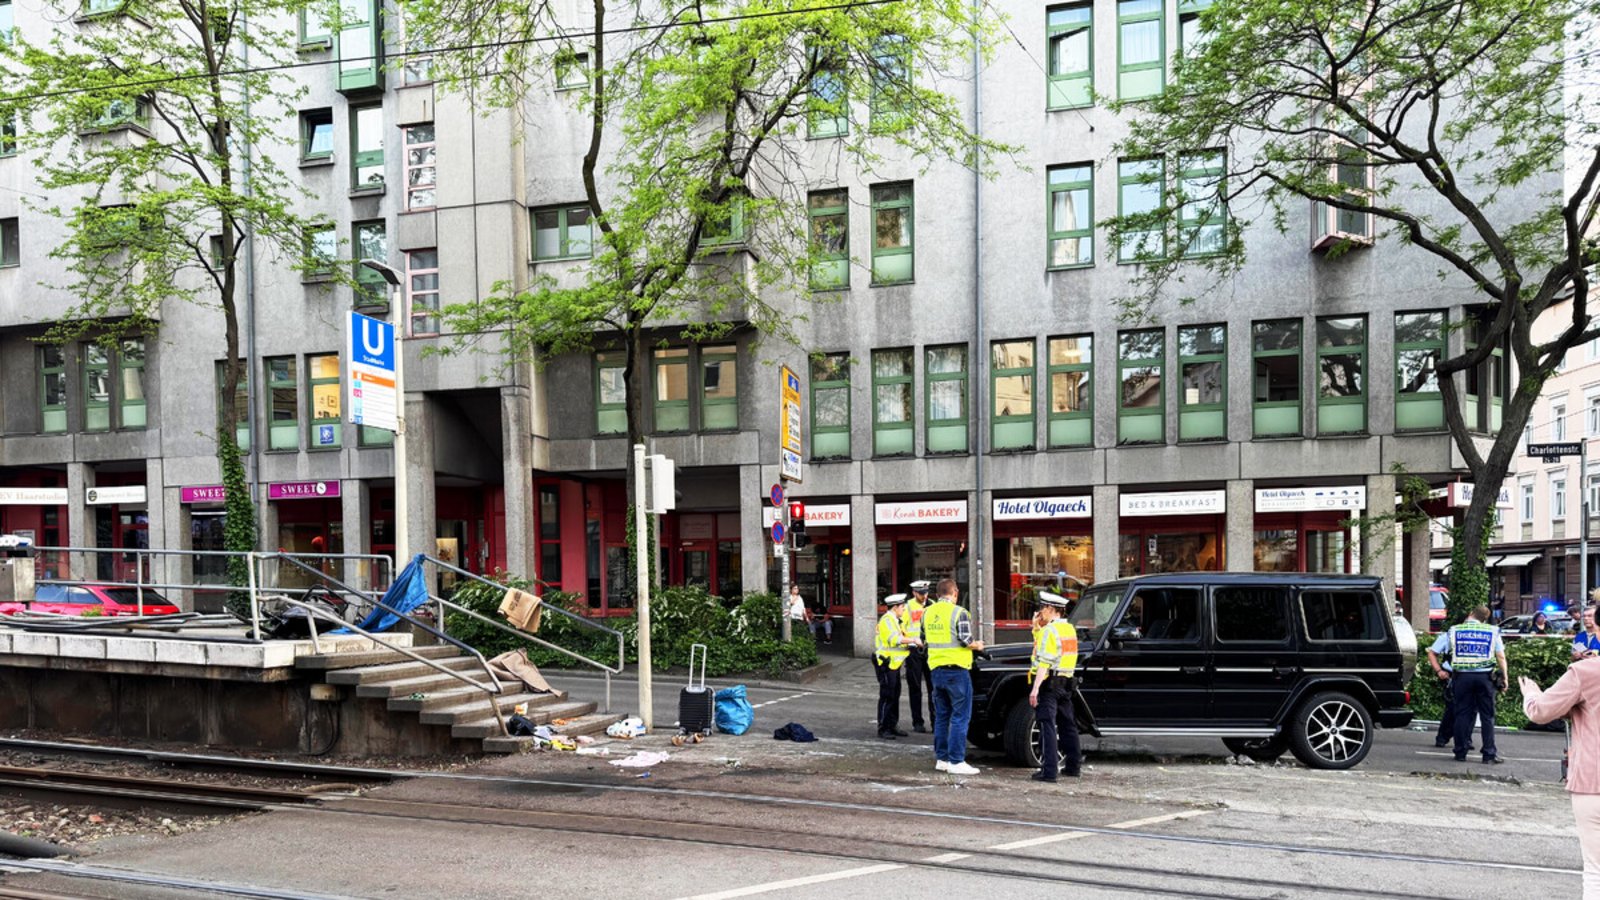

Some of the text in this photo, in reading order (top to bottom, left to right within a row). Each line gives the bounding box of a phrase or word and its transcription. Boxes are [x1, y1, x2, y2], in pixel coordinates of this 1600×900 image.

[362, 318, 384, 356] U
[998, 499, 1087, 516] Hotel Olgaeck
[1128, 501, 1147, 509] BED
[1159, 498, 1217, 508] BREAKFAST
[804, 511, 844, 521] BAKERY
[917, 508, 960, 518] BAKERY
[1458, 644, 1488, 654] POLIZEI
